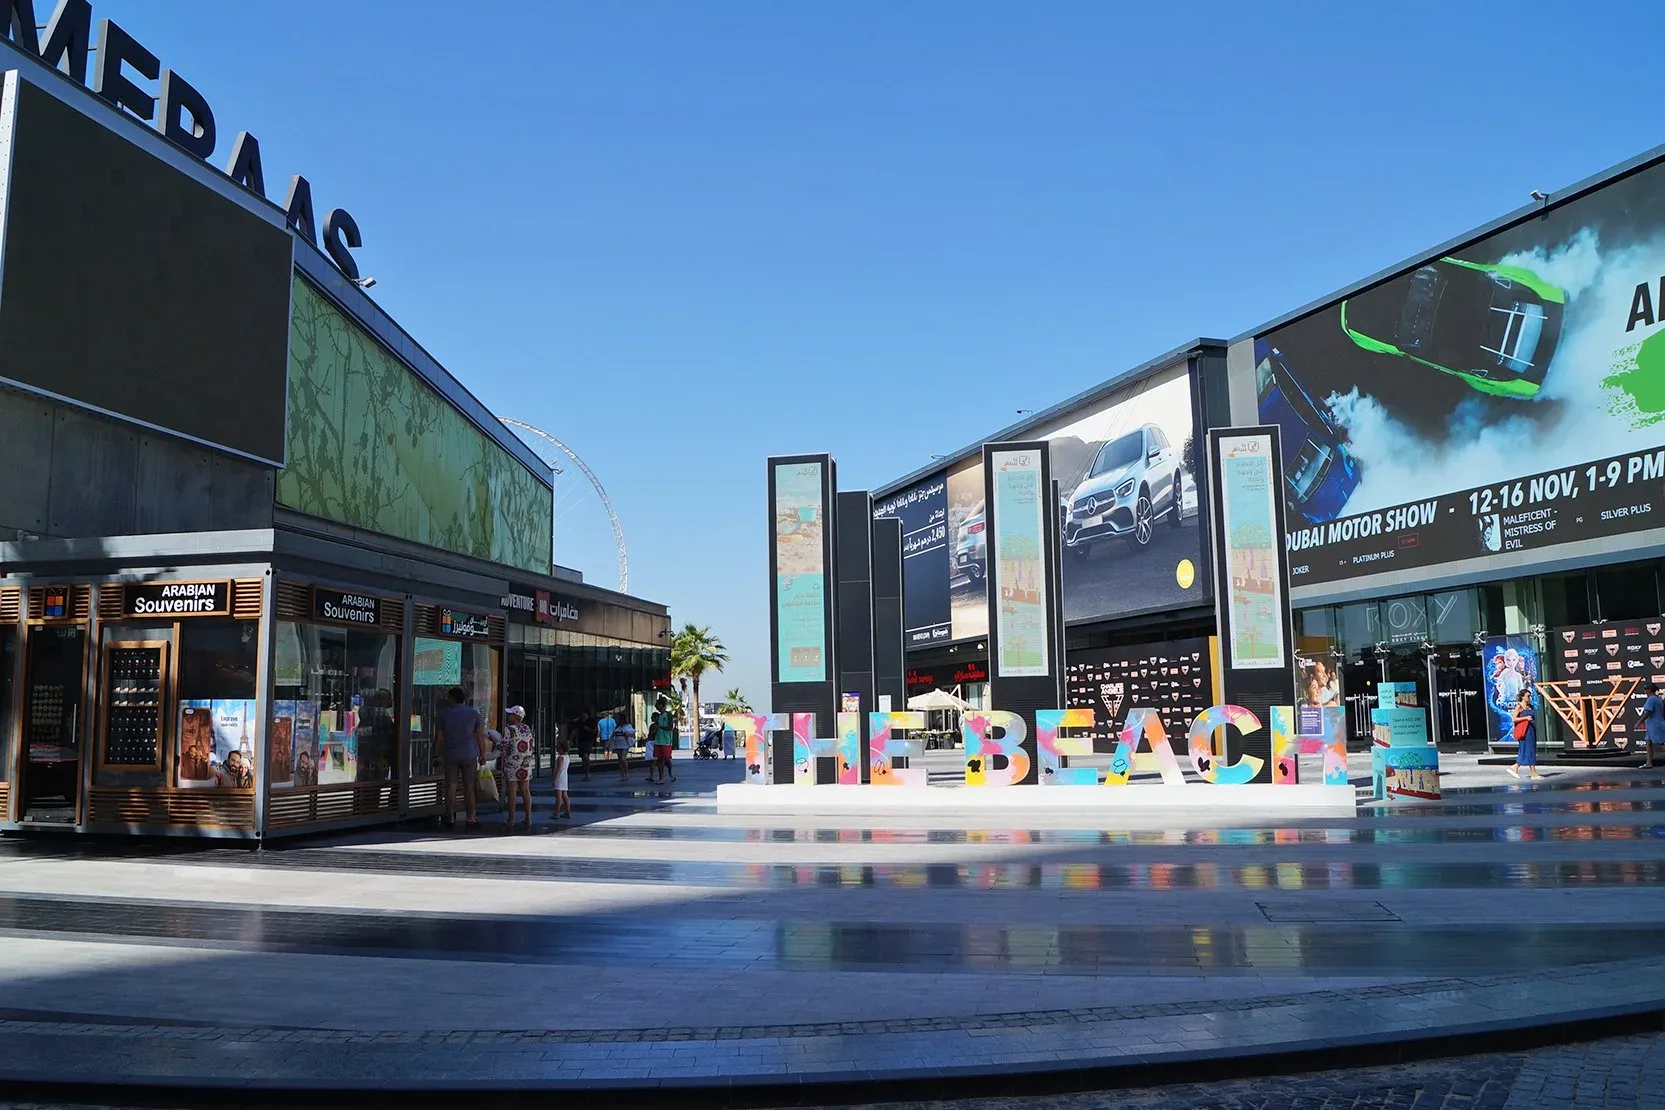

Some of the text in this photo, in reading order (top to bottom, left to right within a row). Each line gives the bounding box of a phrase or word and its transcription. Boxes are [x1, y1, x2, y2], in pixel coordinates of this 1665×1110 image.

[1625, 270, 1665, 333] A
[1469, 450, 1665, 515] 12-16 NOV, 1-9 PM
[1503, 507, 1552, 525] MALEFICENT
[1600, 503, 1652, 520] SILVER PLUS
[1286, 525, 1325, 552] DUBAI
[1328, 513, 1382, 545] MOTOR
[1385, 501, 1438, 533] SHOW
[1504, 519, 1557, 538] MISTRESS OF
[1505, 539, 1523, 550] EVIL
[1352, 549, 1395, 564] PLATINUM PLUS
[1292, 564, 1310, 576] JOKER
[162, 584, 215, 597] ARABIAN
[134, 596, 215, 613] Souvenirs
[341, 594, 375, 609] ARABIAN
[323, 602, 375, 623] Souvenirs
[1366, 595, 1457, 632] ROXY
[724, 704, 1348, 786] THE BEACH
